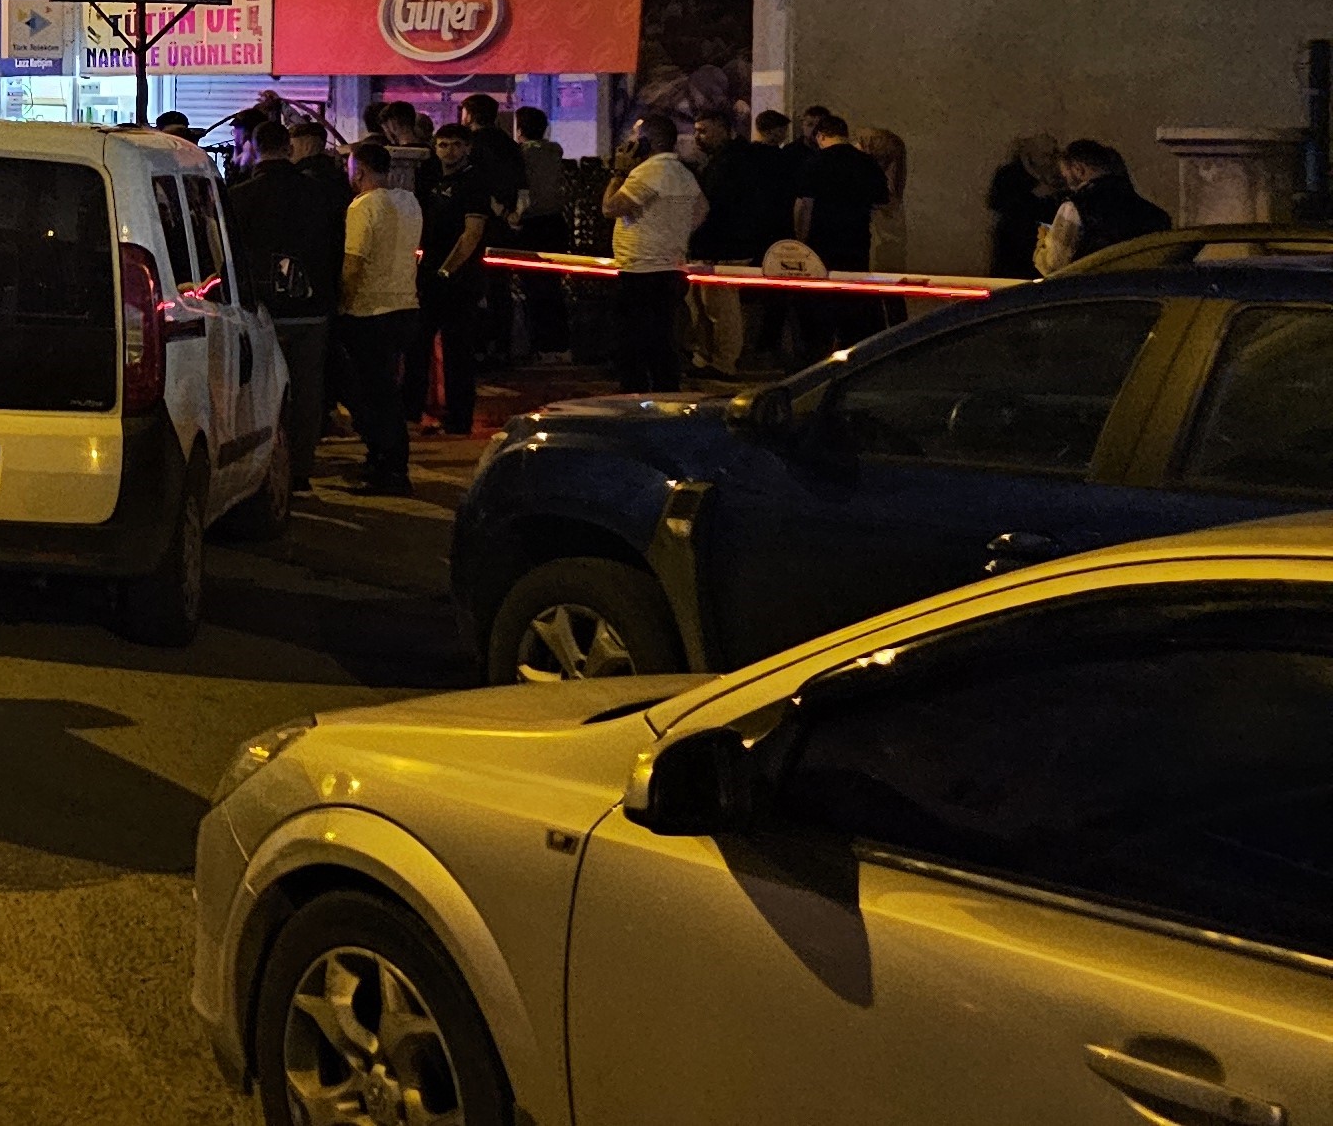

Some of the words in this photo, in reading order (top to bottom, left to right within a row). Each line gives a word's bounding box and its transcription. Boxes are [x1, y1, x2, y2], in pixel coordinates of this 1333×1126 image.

[109, 6, 196, 38] TÜTÜN
[207, 8, 242, 35] VE
[86, 46, 160, 68] NARGLE
[167, 38, 263, 67] ÜRÜNLERİ
